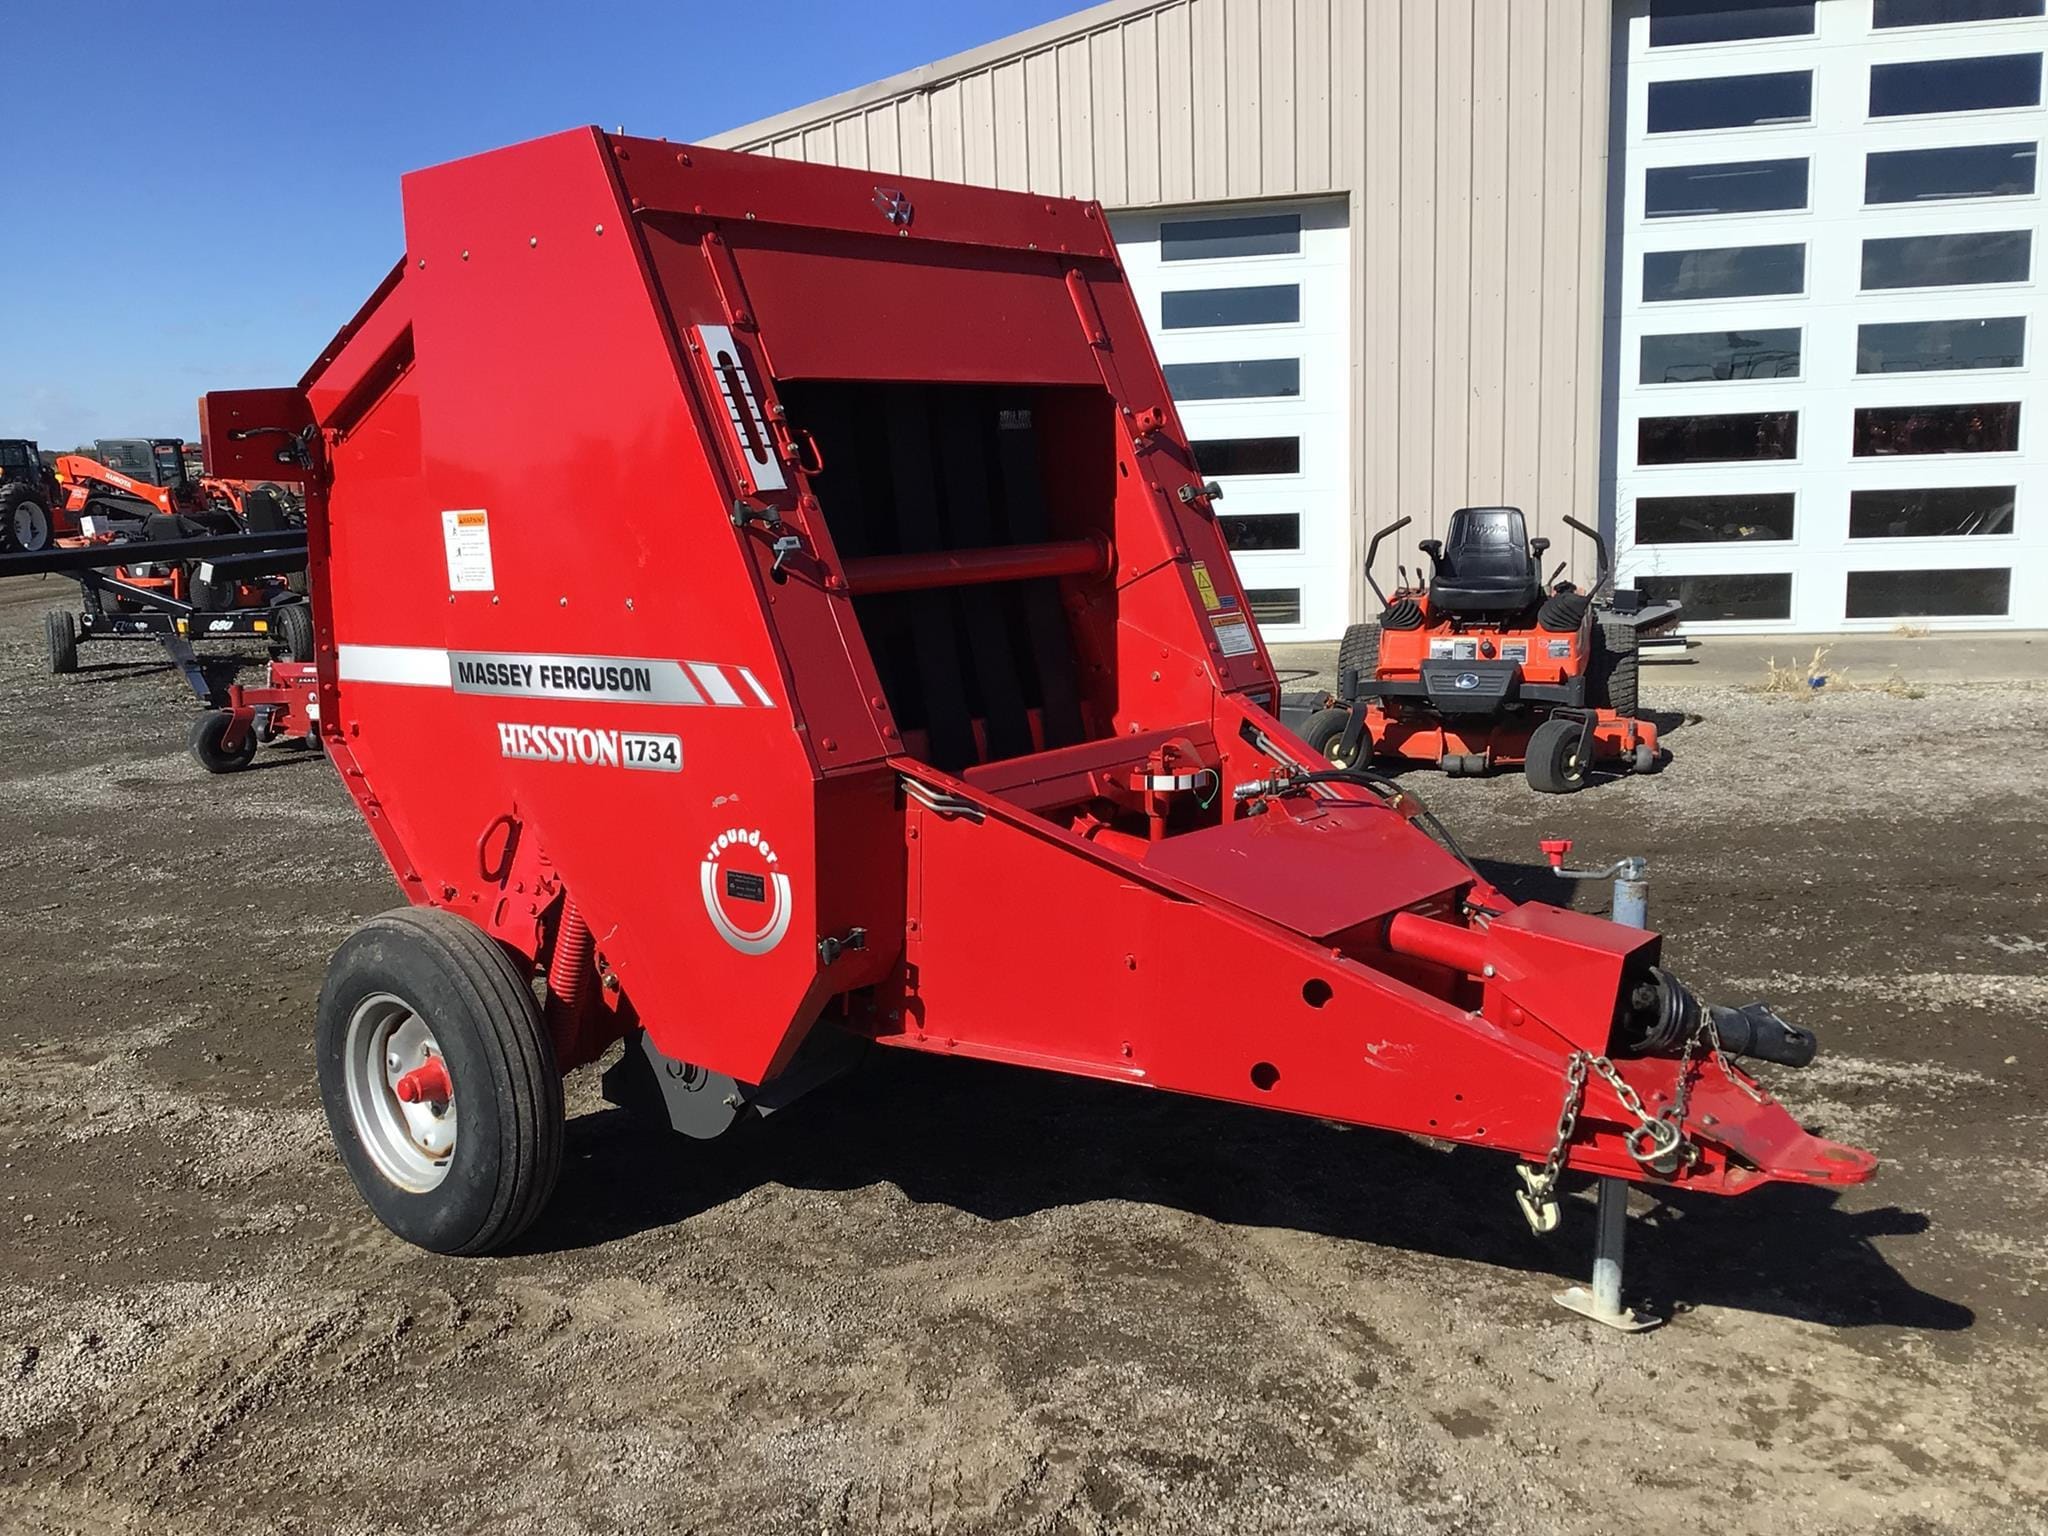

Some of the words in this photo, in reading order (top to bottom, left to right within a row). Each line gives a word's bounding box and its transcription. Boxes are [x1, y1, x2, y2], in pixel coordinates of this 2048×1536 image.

[105, 472, 132, 488] KUBOTA
[458, 661, 533, 687] MASSEY
[539, 665, 651, 692] FERGUSON
[497, 722, 620, 767] HESSTON
[625, 740, 677, 764] 1734
